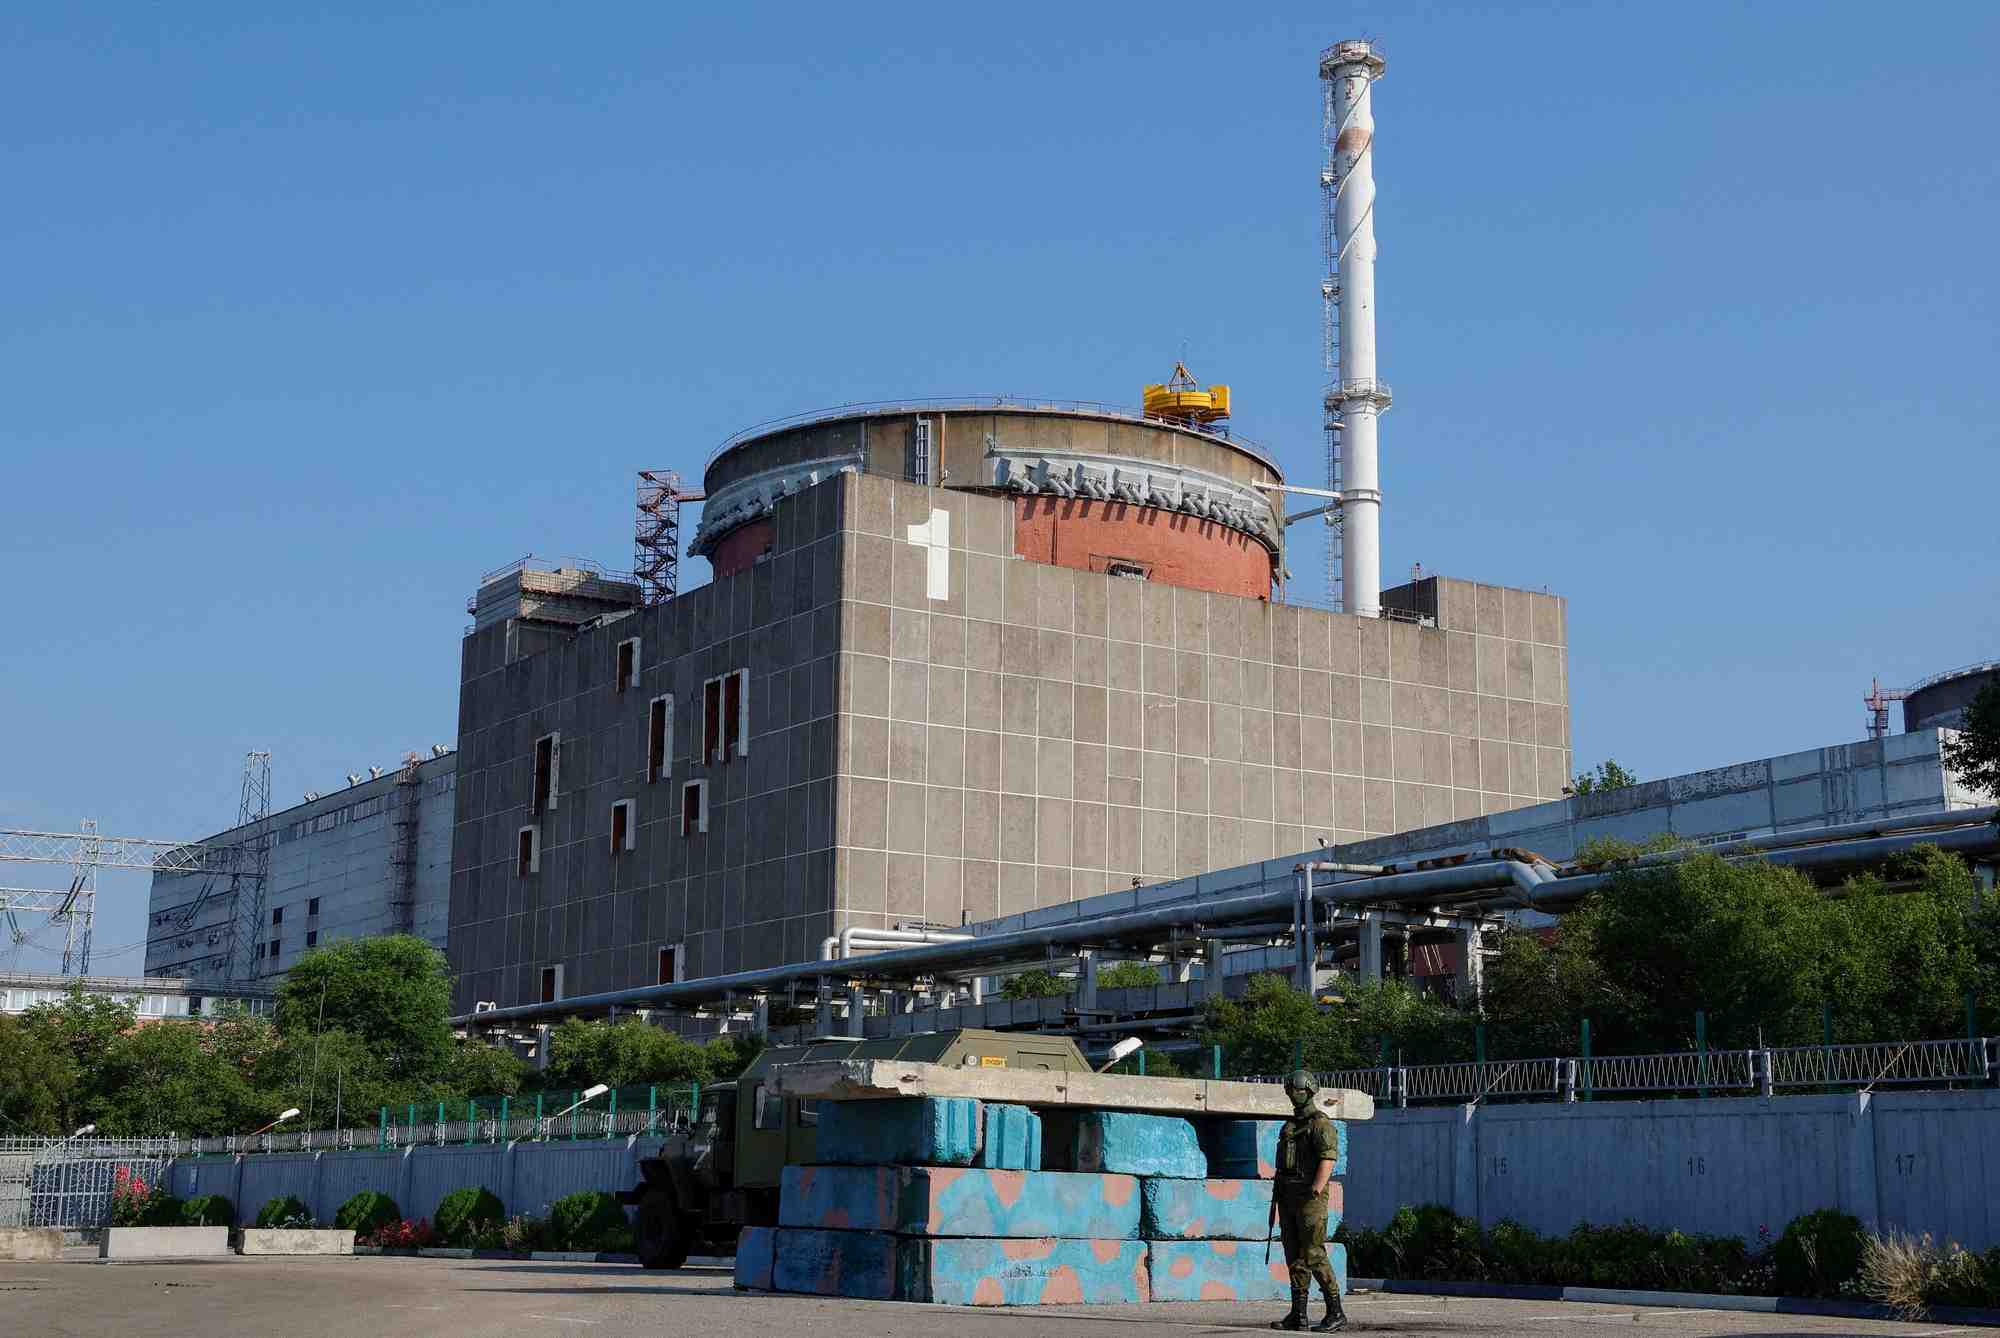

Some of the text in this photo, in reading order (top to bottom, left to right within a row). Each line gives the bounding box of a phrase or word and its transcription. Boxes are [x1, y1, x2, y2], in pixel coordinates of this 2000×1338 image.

[908, 508, 950, 601] 1
[1493, 1157, 1508, 1176] 15
[1687, 1156, 1706, 1177] 16
[1895, 1153, 1915, 1176] 17
